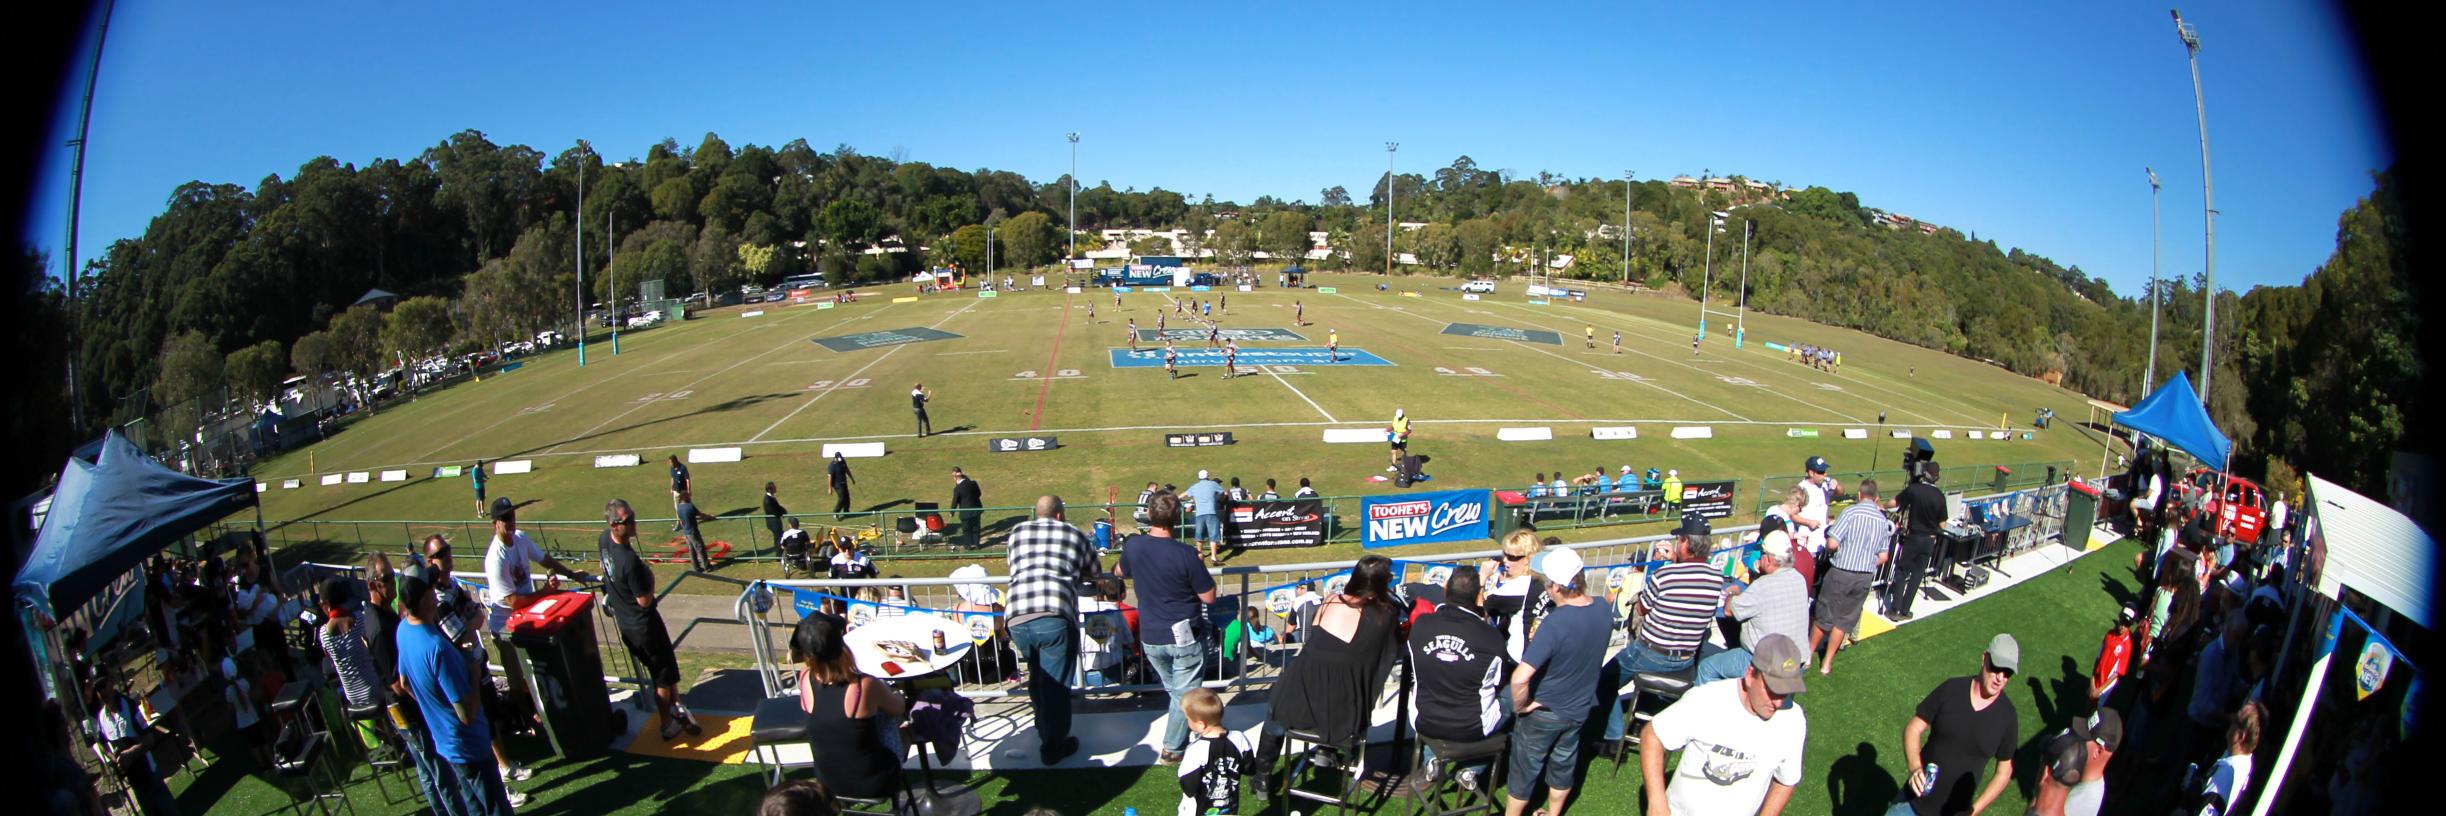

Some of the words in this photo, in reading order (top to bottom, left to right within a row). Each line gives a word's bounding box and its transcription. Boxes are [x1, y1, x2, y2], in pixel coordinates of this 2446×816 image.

[1129, 270, 1152, 278] NEW
[1254, 505, 1296, 520] Accent
[1372, 502, 1428, 517] TOOHEYS
[1369, 515, 1429, 542] NEW
[1431, 502, 1481, 529] Crew
[1422, 639, 1475, 662] SEAGULLS
